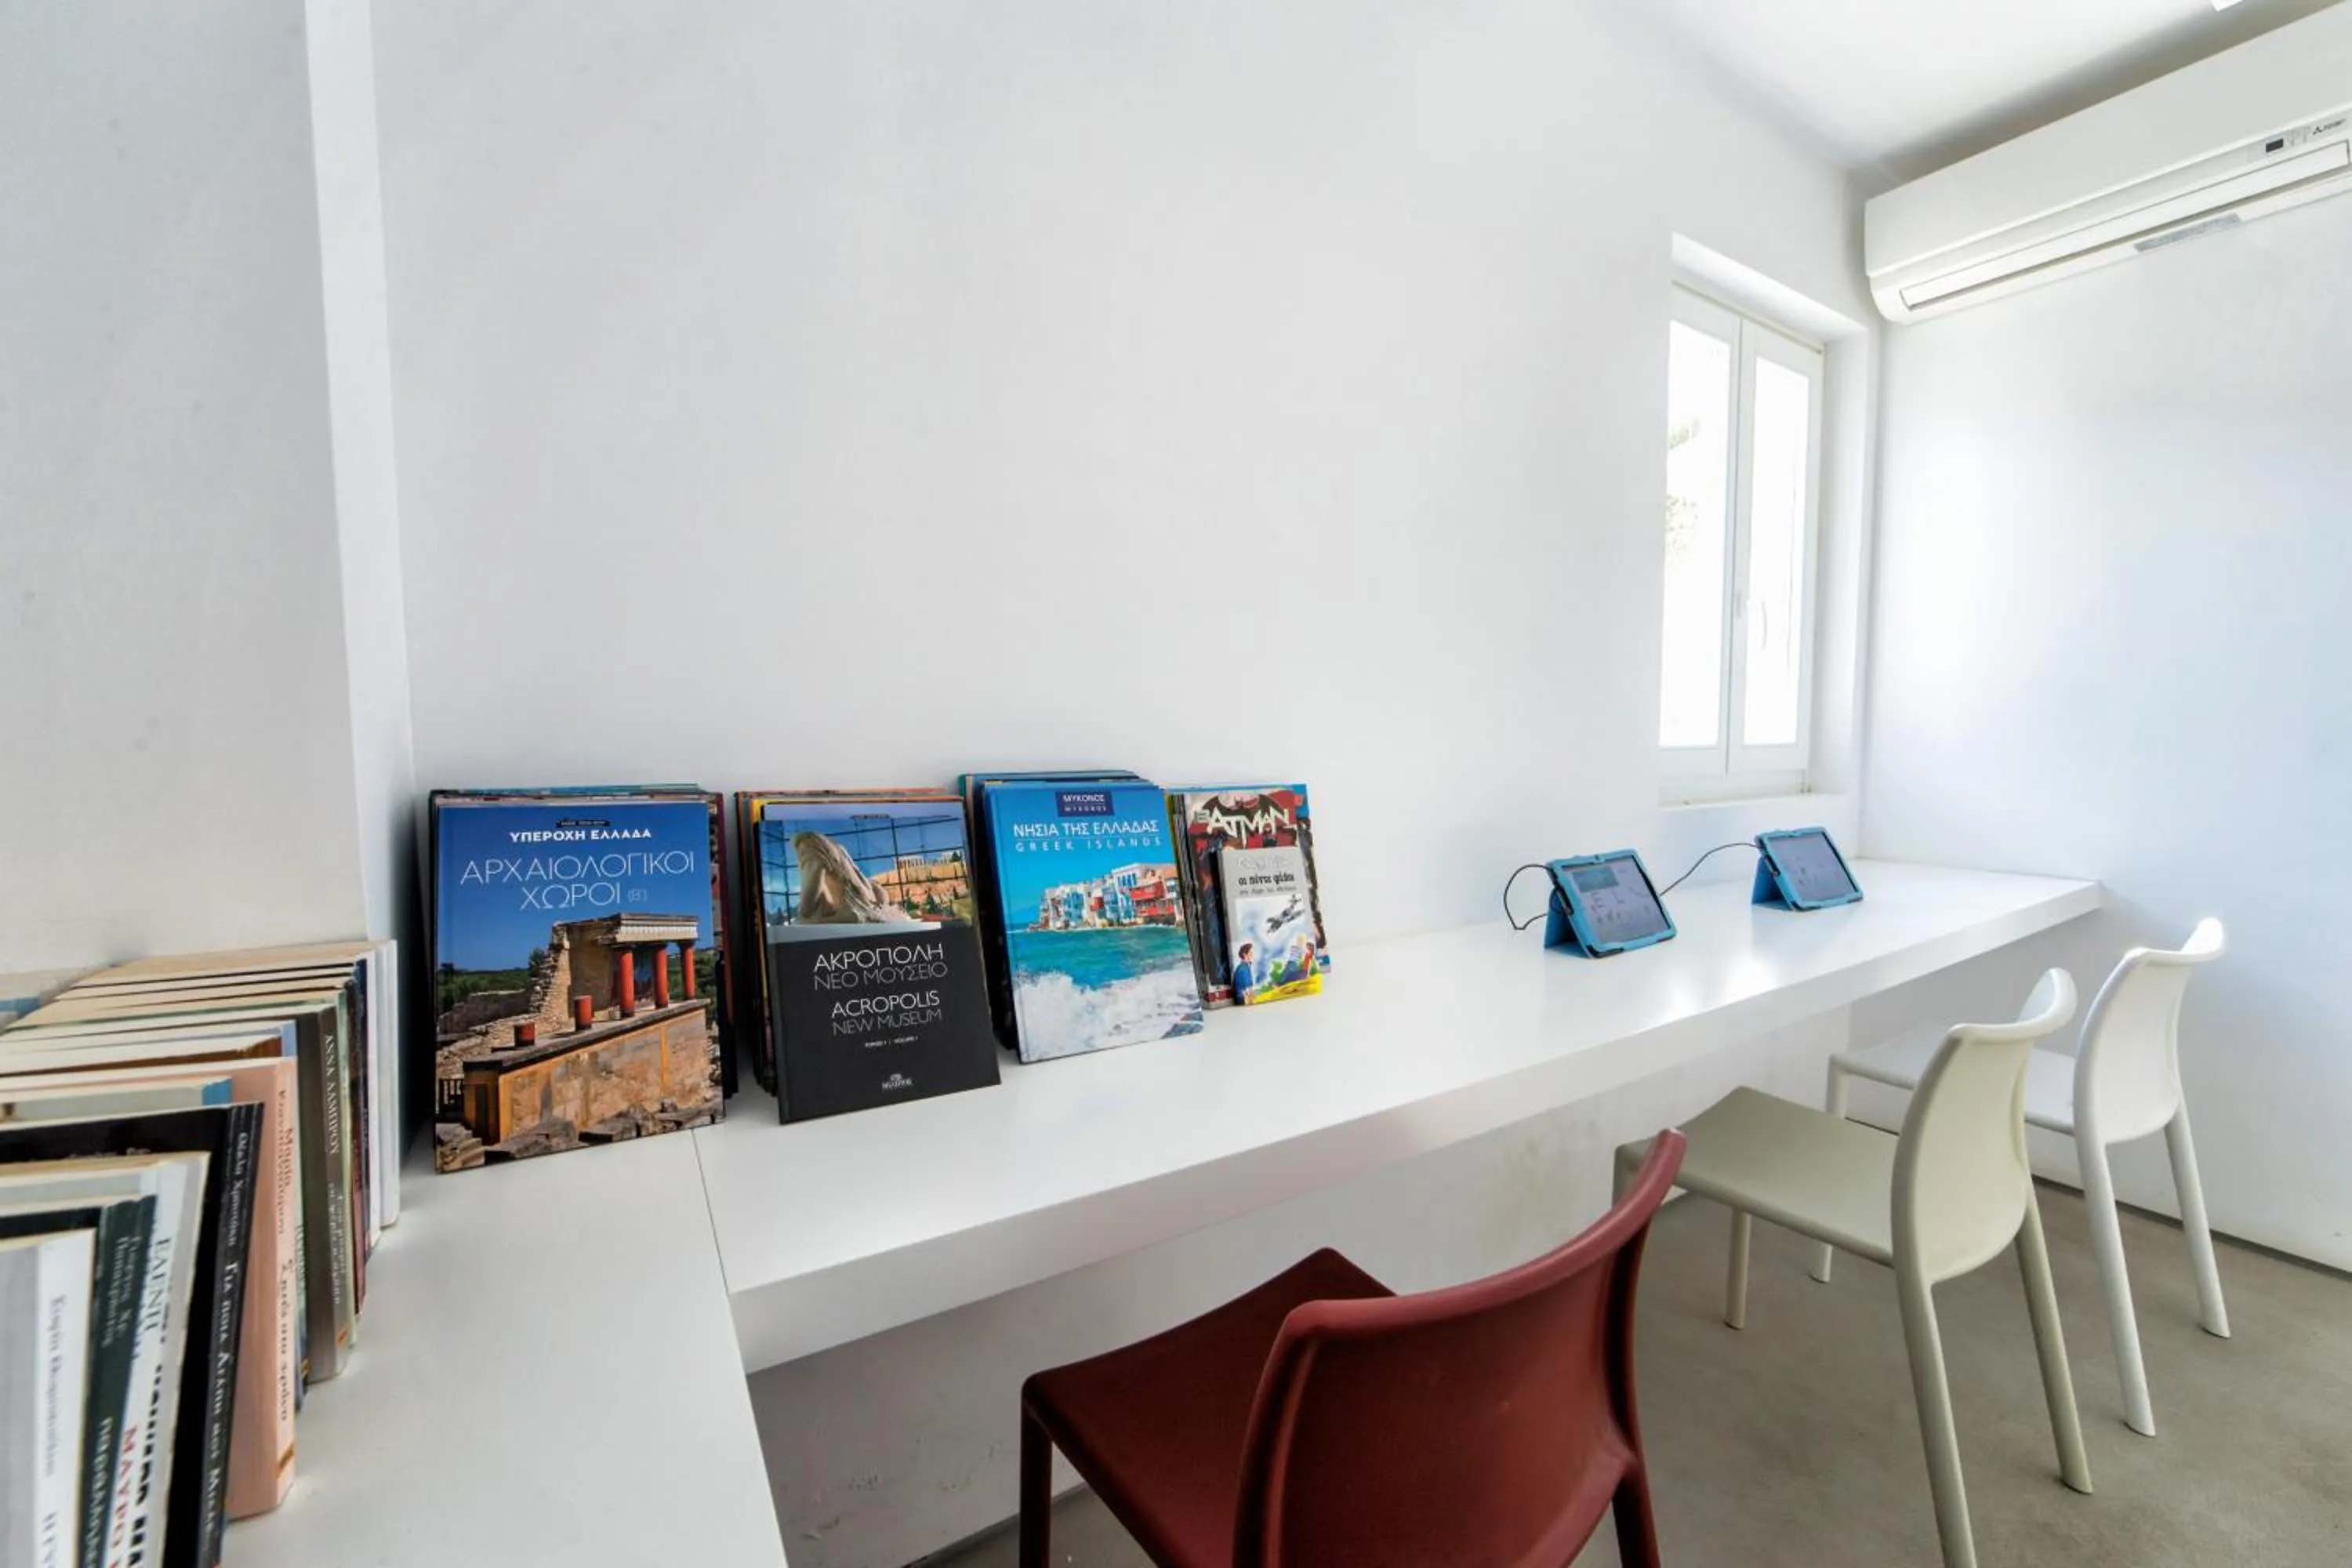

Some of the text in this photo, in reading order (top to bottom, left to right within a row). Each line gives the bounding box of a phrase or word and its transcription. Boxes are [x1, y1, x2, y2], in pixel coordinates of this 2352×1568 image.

[510, 827, 652, 844] ΥΠΕΡΟΧΗ ΕΛΛΑΔΑ
[1013, 820, 1160, 837] ΝΗΣΙΑ ΤΗΣ ΕΛΛΑΔΑΣ
[1015, 837, 1162, 853] GREEK ISLANDS
[460, 851, 695, 885] ΑΡΧΑΙΟΛΟΓΙΚΟΙ
[520, 882, 621, 910] ΧΩΡΟΙ
[813, 943, 944, 974] ΑΚΡΟΠΟΛΗ
[814, 961, 948, 992] ΝΕΟ ΜΟΥΣΕΙΟ
[831, 990, 940, 1018] ACROPOLIS
[833, 1008, 942, 1036] NEW MUSEUM
